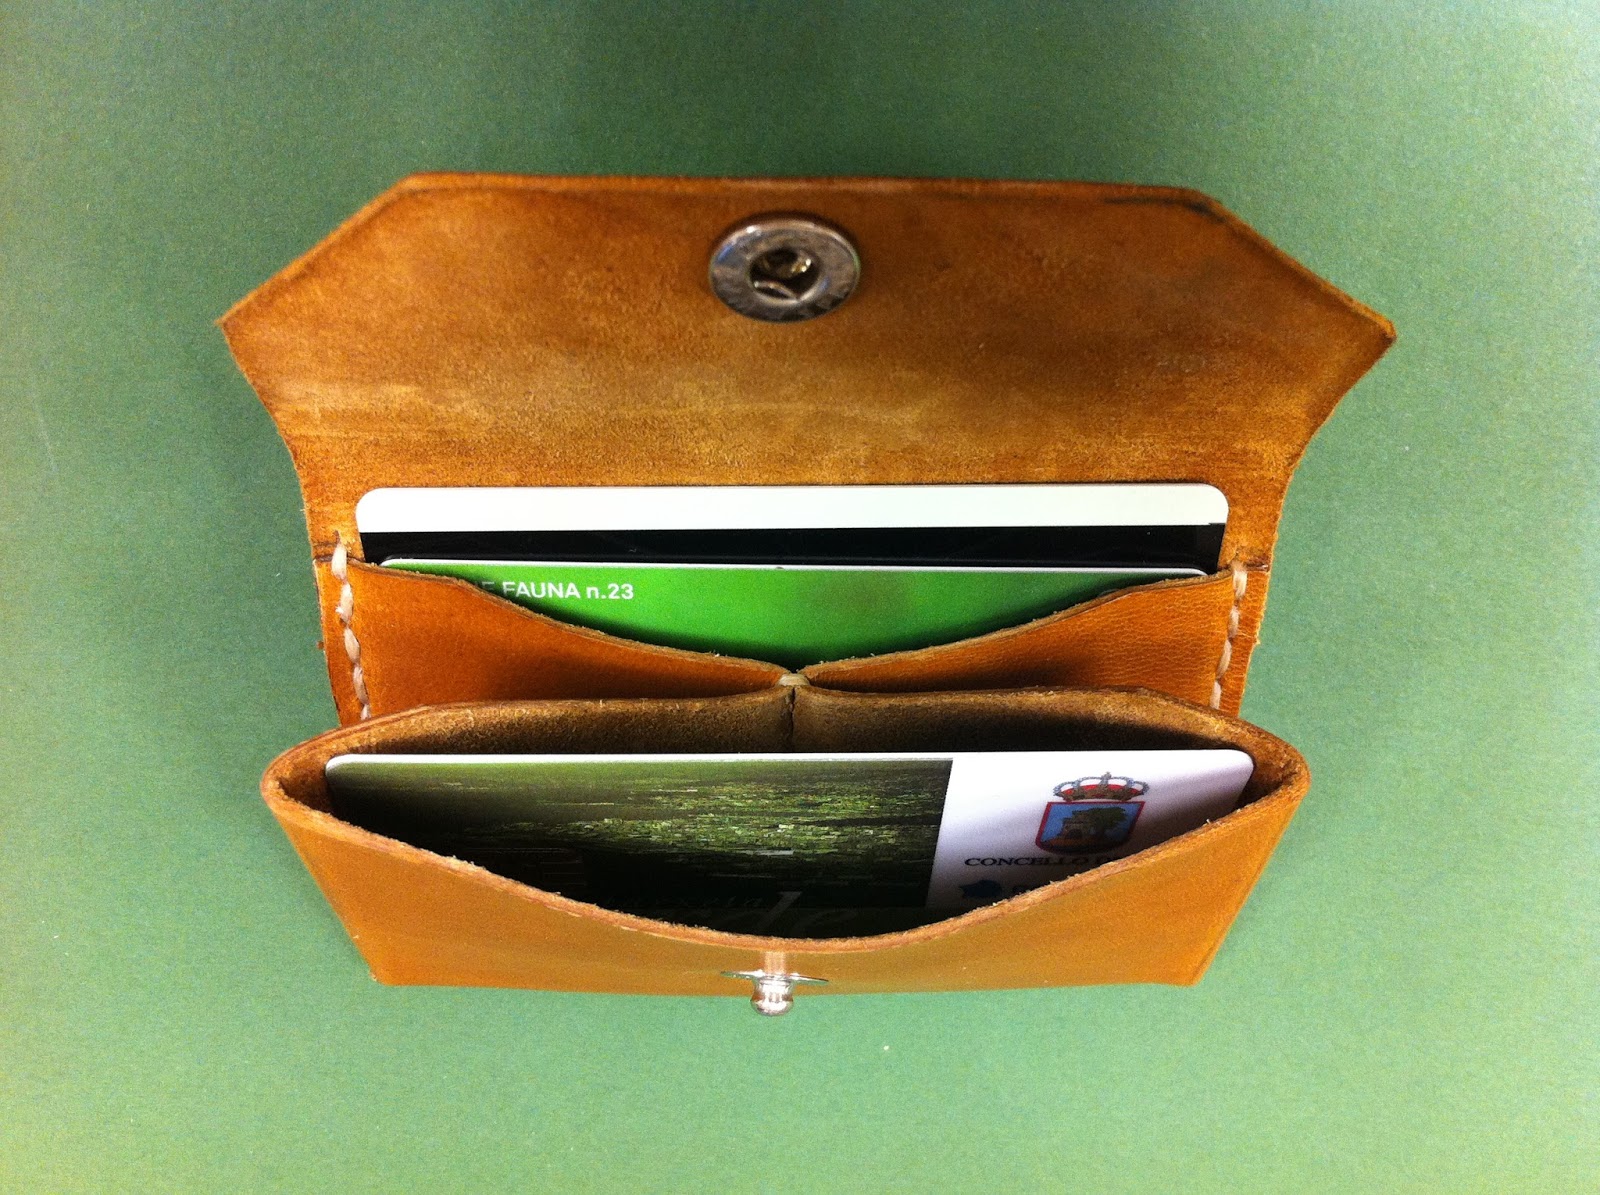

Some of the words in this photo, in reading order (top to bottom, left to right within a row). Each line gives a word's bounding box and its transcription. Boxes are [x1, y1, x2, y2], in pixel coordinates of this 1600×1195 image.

[502, 581, 581, 599] FAUNA
[586, 582, 635, 600] n.23
[964, 857, 1089, 867] CONCELLO
